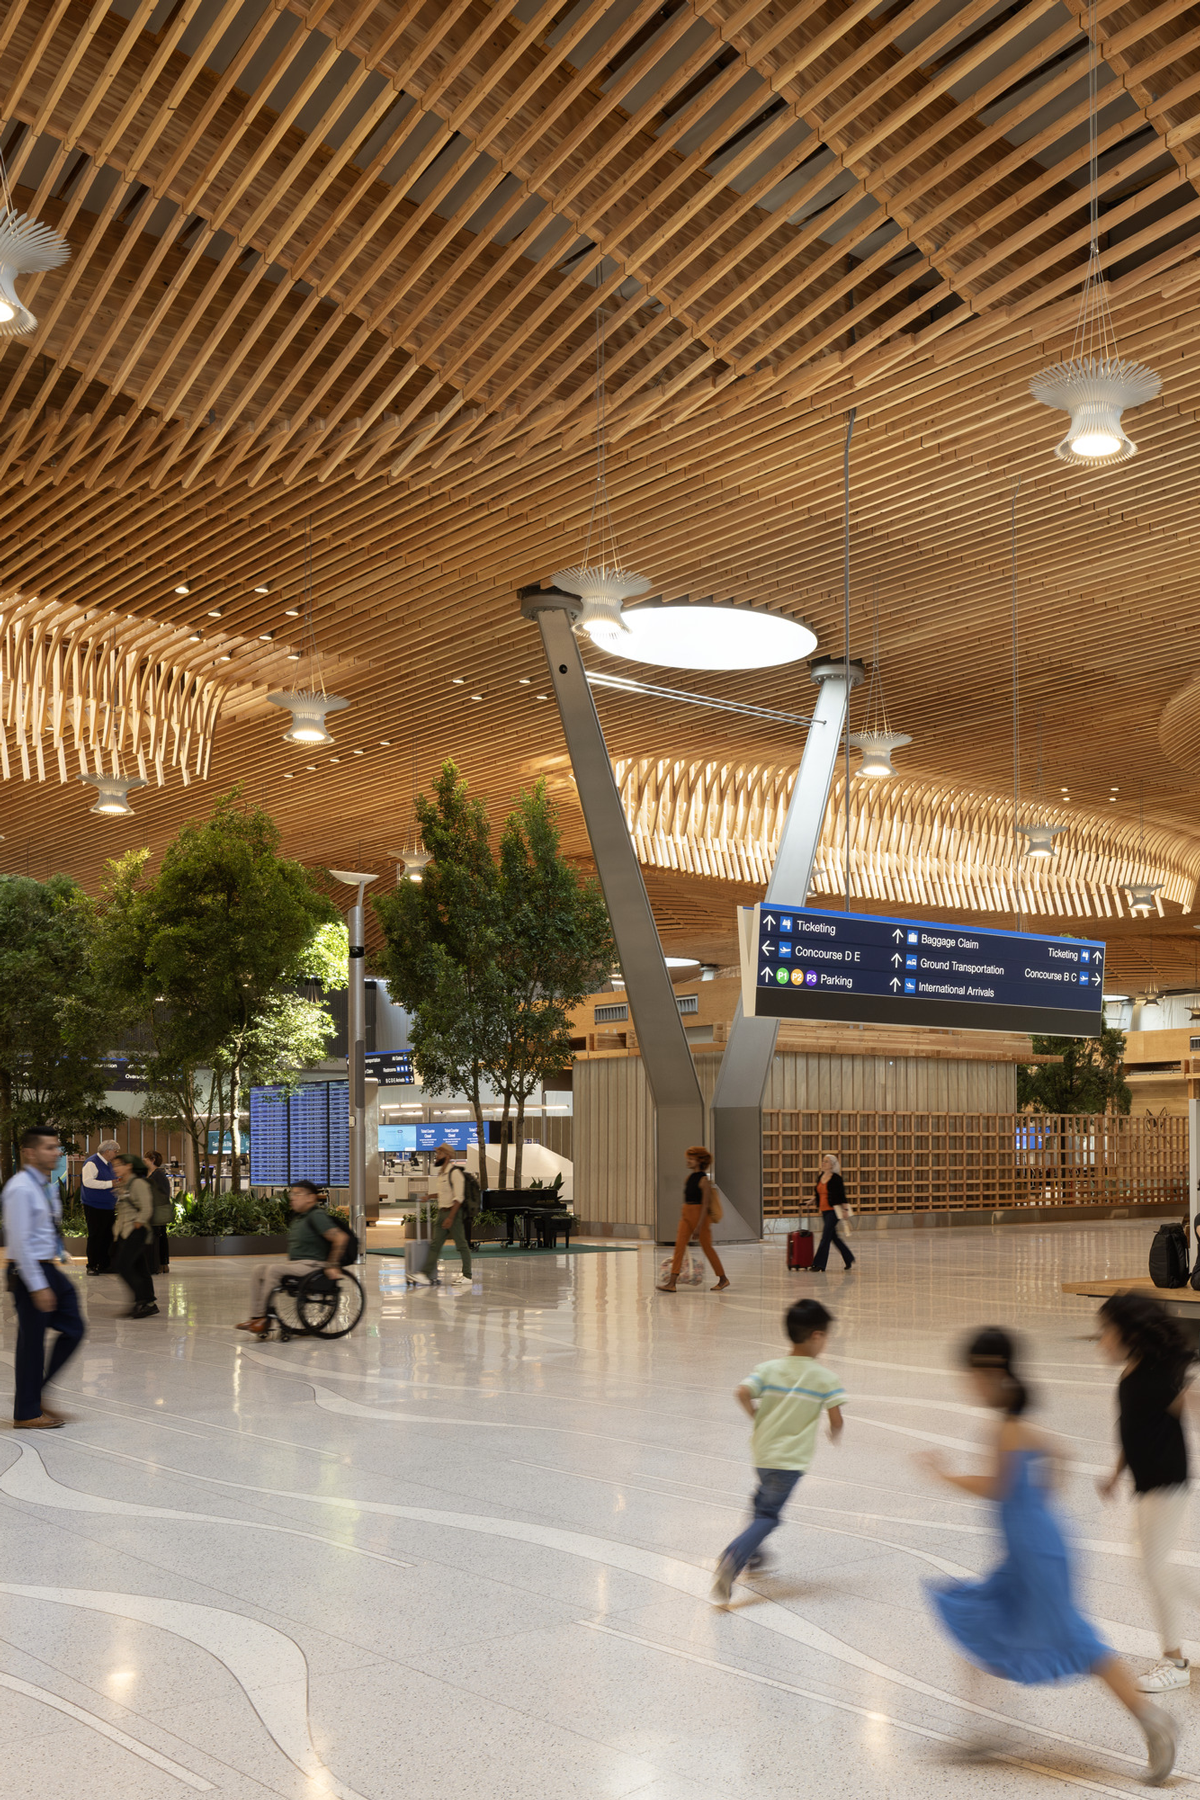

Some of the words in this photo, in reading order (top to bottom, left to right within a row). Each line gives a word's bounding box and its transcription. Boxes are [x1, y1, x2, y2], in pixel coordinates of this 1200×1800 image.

[797, 920, 836, 936] Ticketing
[921, 934, 956, 948] Baggage
[957, 938, 979, 949] Claim
[795, 945, 842, 960] Concourse
[845, 950, 852, 961] D
[854, 951, 861, 962] E
[1048, 947, 1078, 961] Ticketing
[920, 958, 949, 970] Ground
[951, 961, 1004, 975] Transportation
[777, 972, 788, 980] P1
[792, 973, 802, 981] P2
[806, 974, 817, 983] P3
[820, 974, 853, 988] Parking
[1024, 968, 1062, 981] Concourse
[1063, 972, 1069, 981] B
[1071, 973, 1077, 982] C
[918, 982, 965, 995] International
[966, 986, 994, 997] Arrivals
